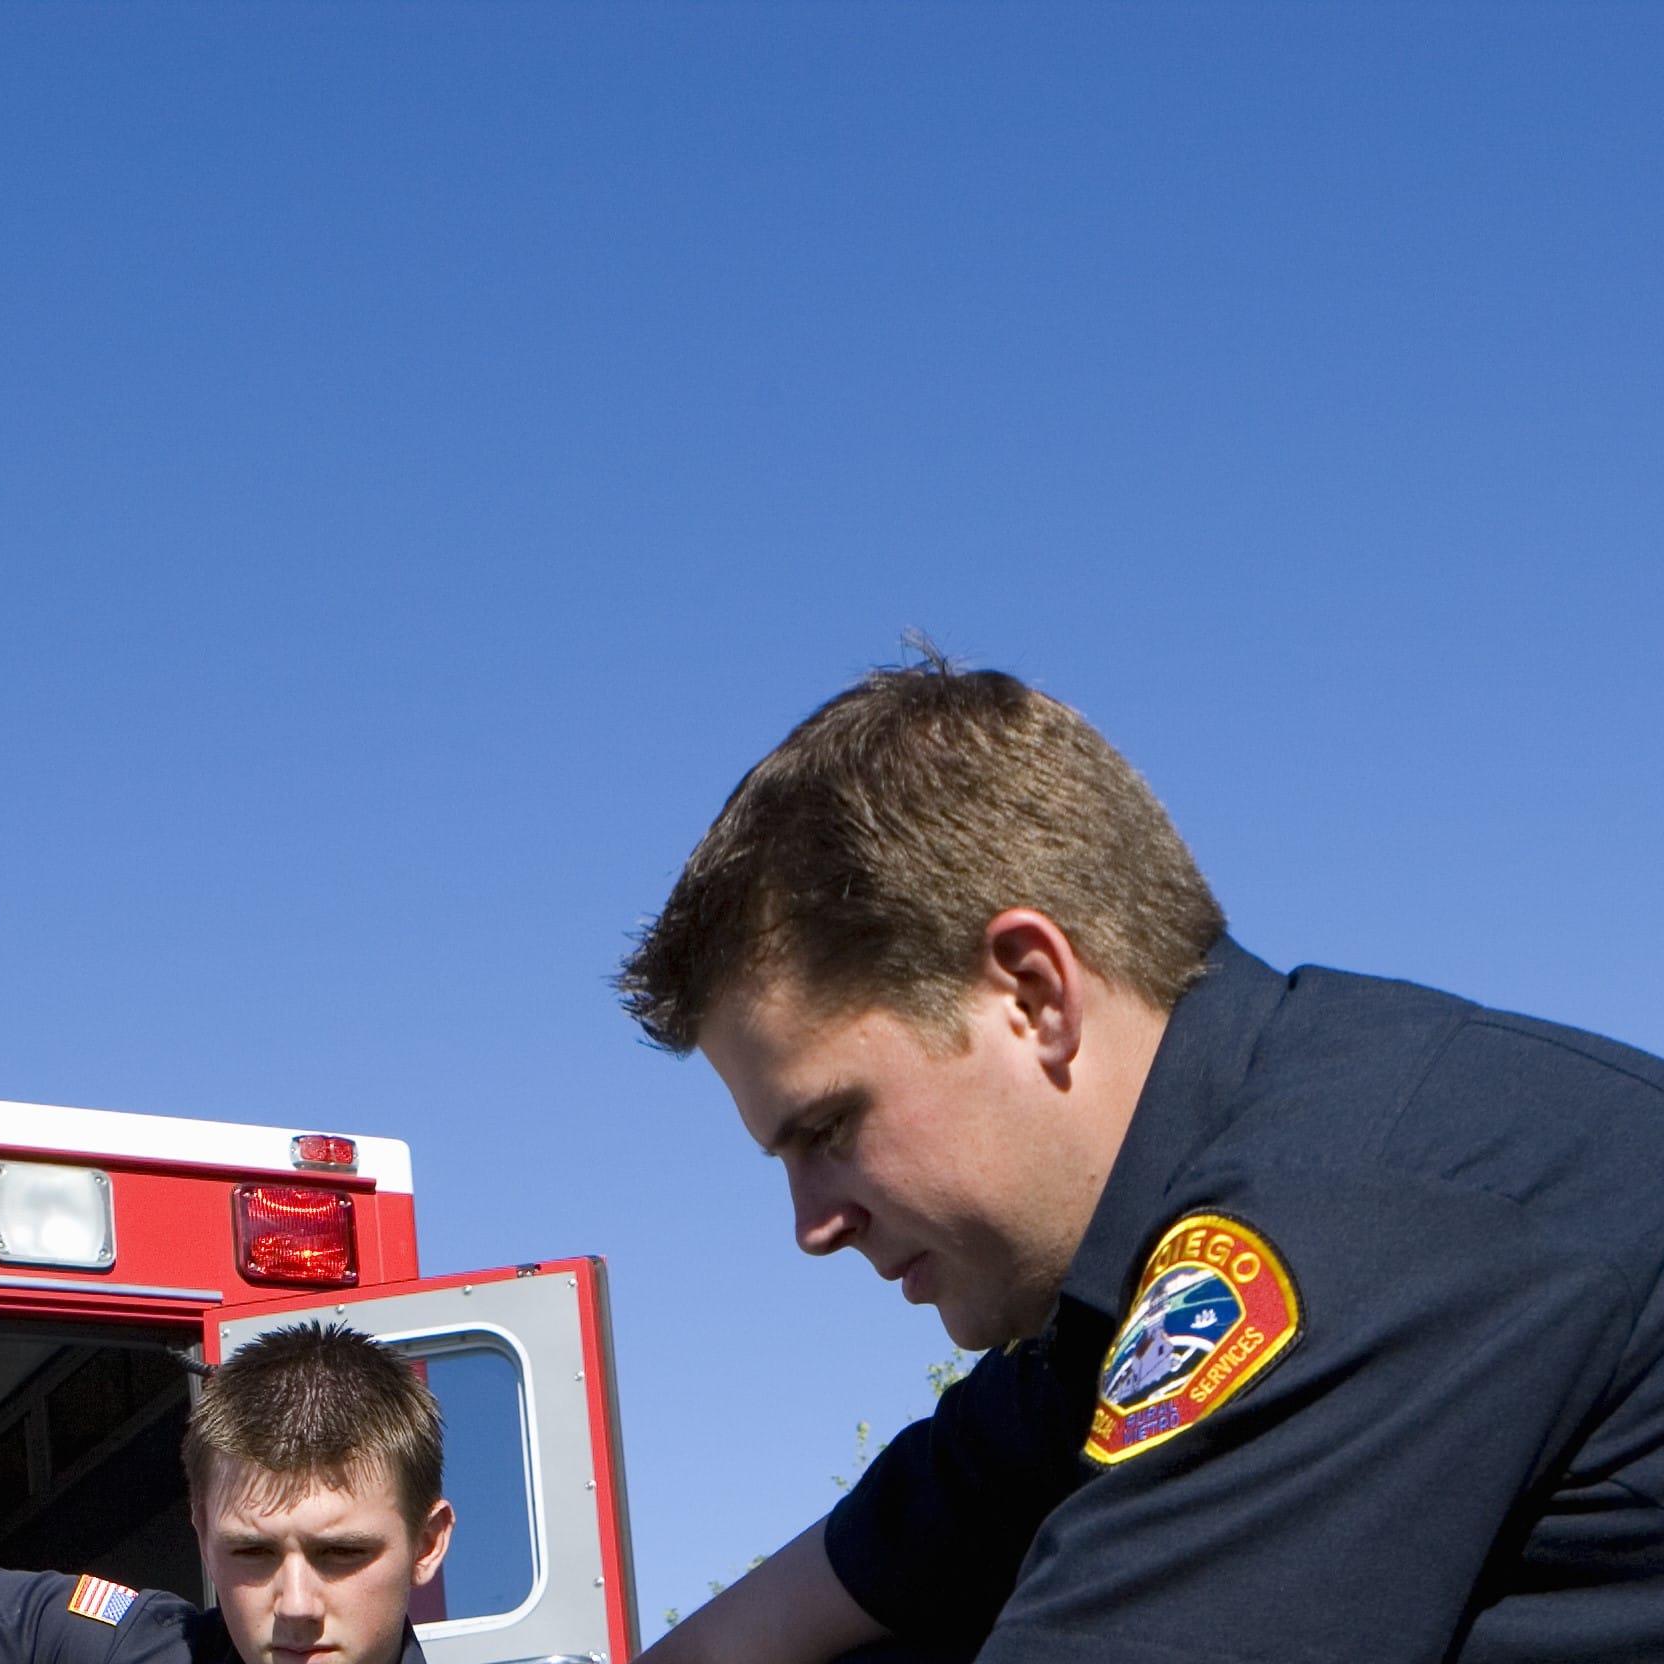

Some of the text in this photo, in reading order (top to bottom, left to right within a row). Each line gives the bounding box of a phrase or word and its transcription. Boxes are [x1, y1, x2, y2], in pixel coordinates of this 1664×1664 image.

[1154, 1229, 1261, 1284] DIEGO
[1189, 1326, 1265, 1403] SERVICES
[1124, 1412, 1180, 1445] METRO
[1126, 1399, 1178, 1426] RURAL
